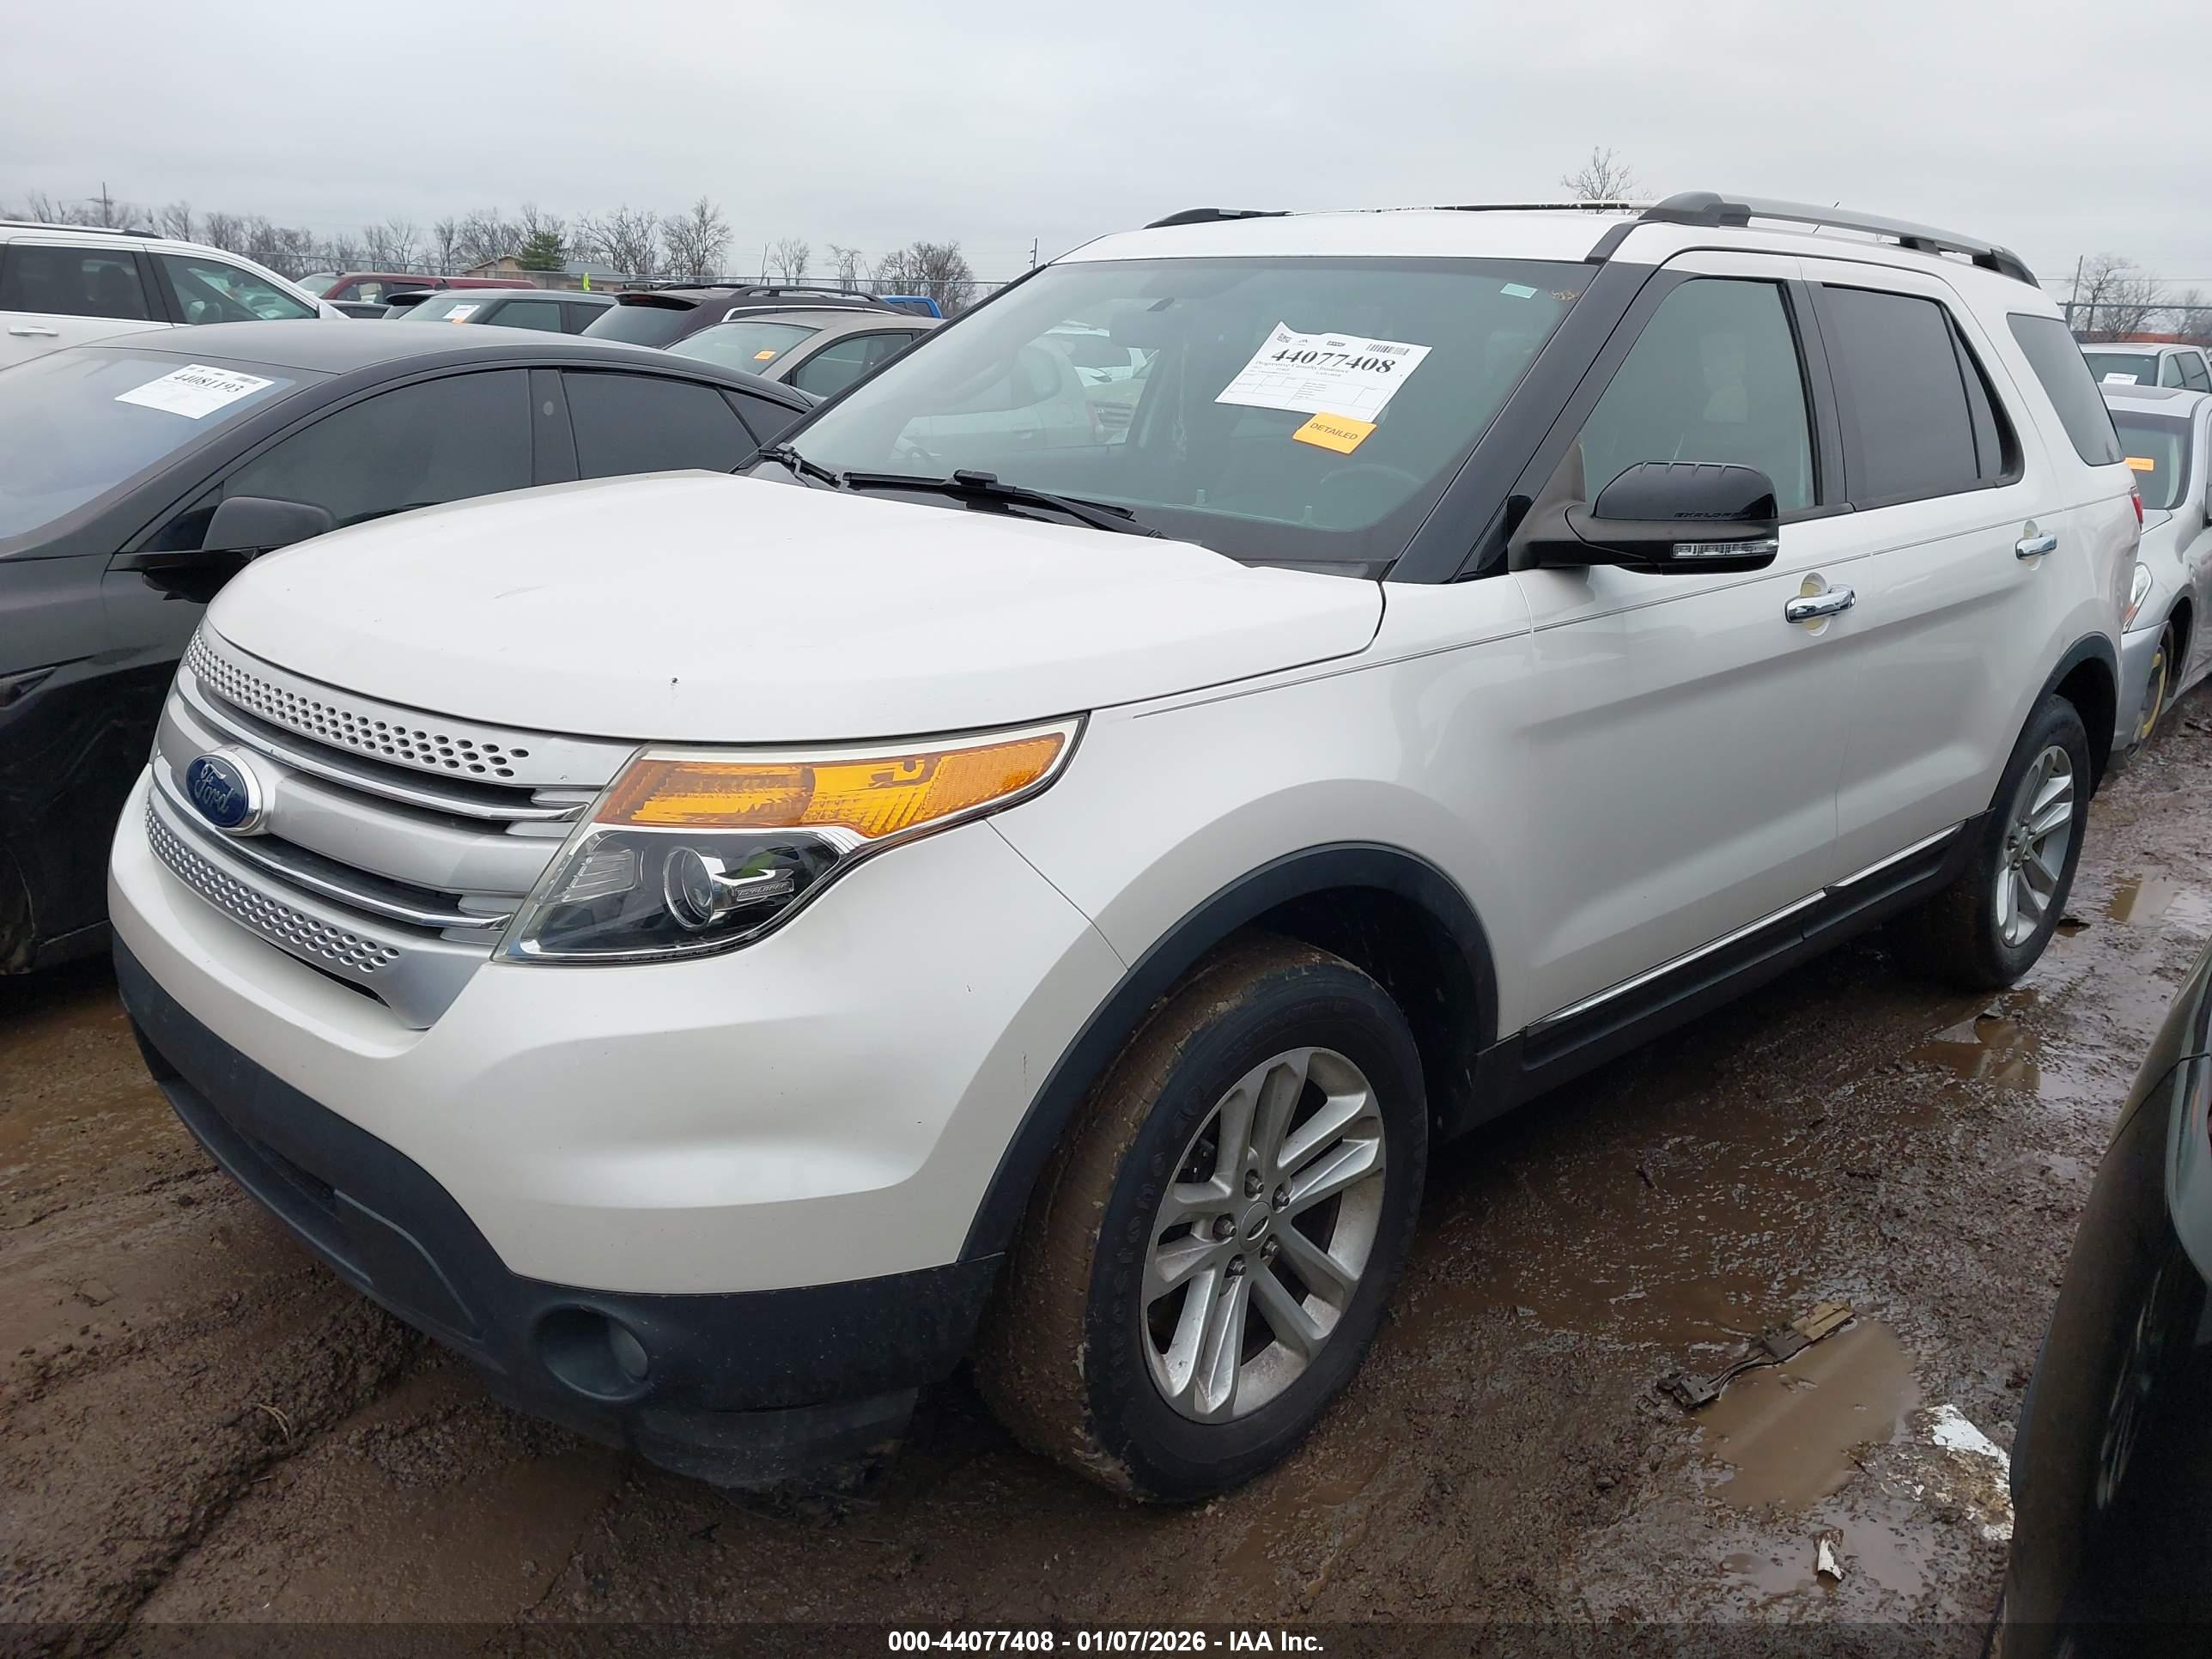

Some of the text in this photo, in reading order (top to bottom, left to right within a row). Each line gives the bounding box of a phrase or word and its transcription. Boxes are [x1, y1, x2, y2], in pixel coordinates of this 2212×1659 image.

[1271, 349, 1396, 374] 44077408
[173, 374, 244, 392] 44081193
[1310, 422, 1358, 441] DETAILED
[194, 763, 234, 814] Ford
